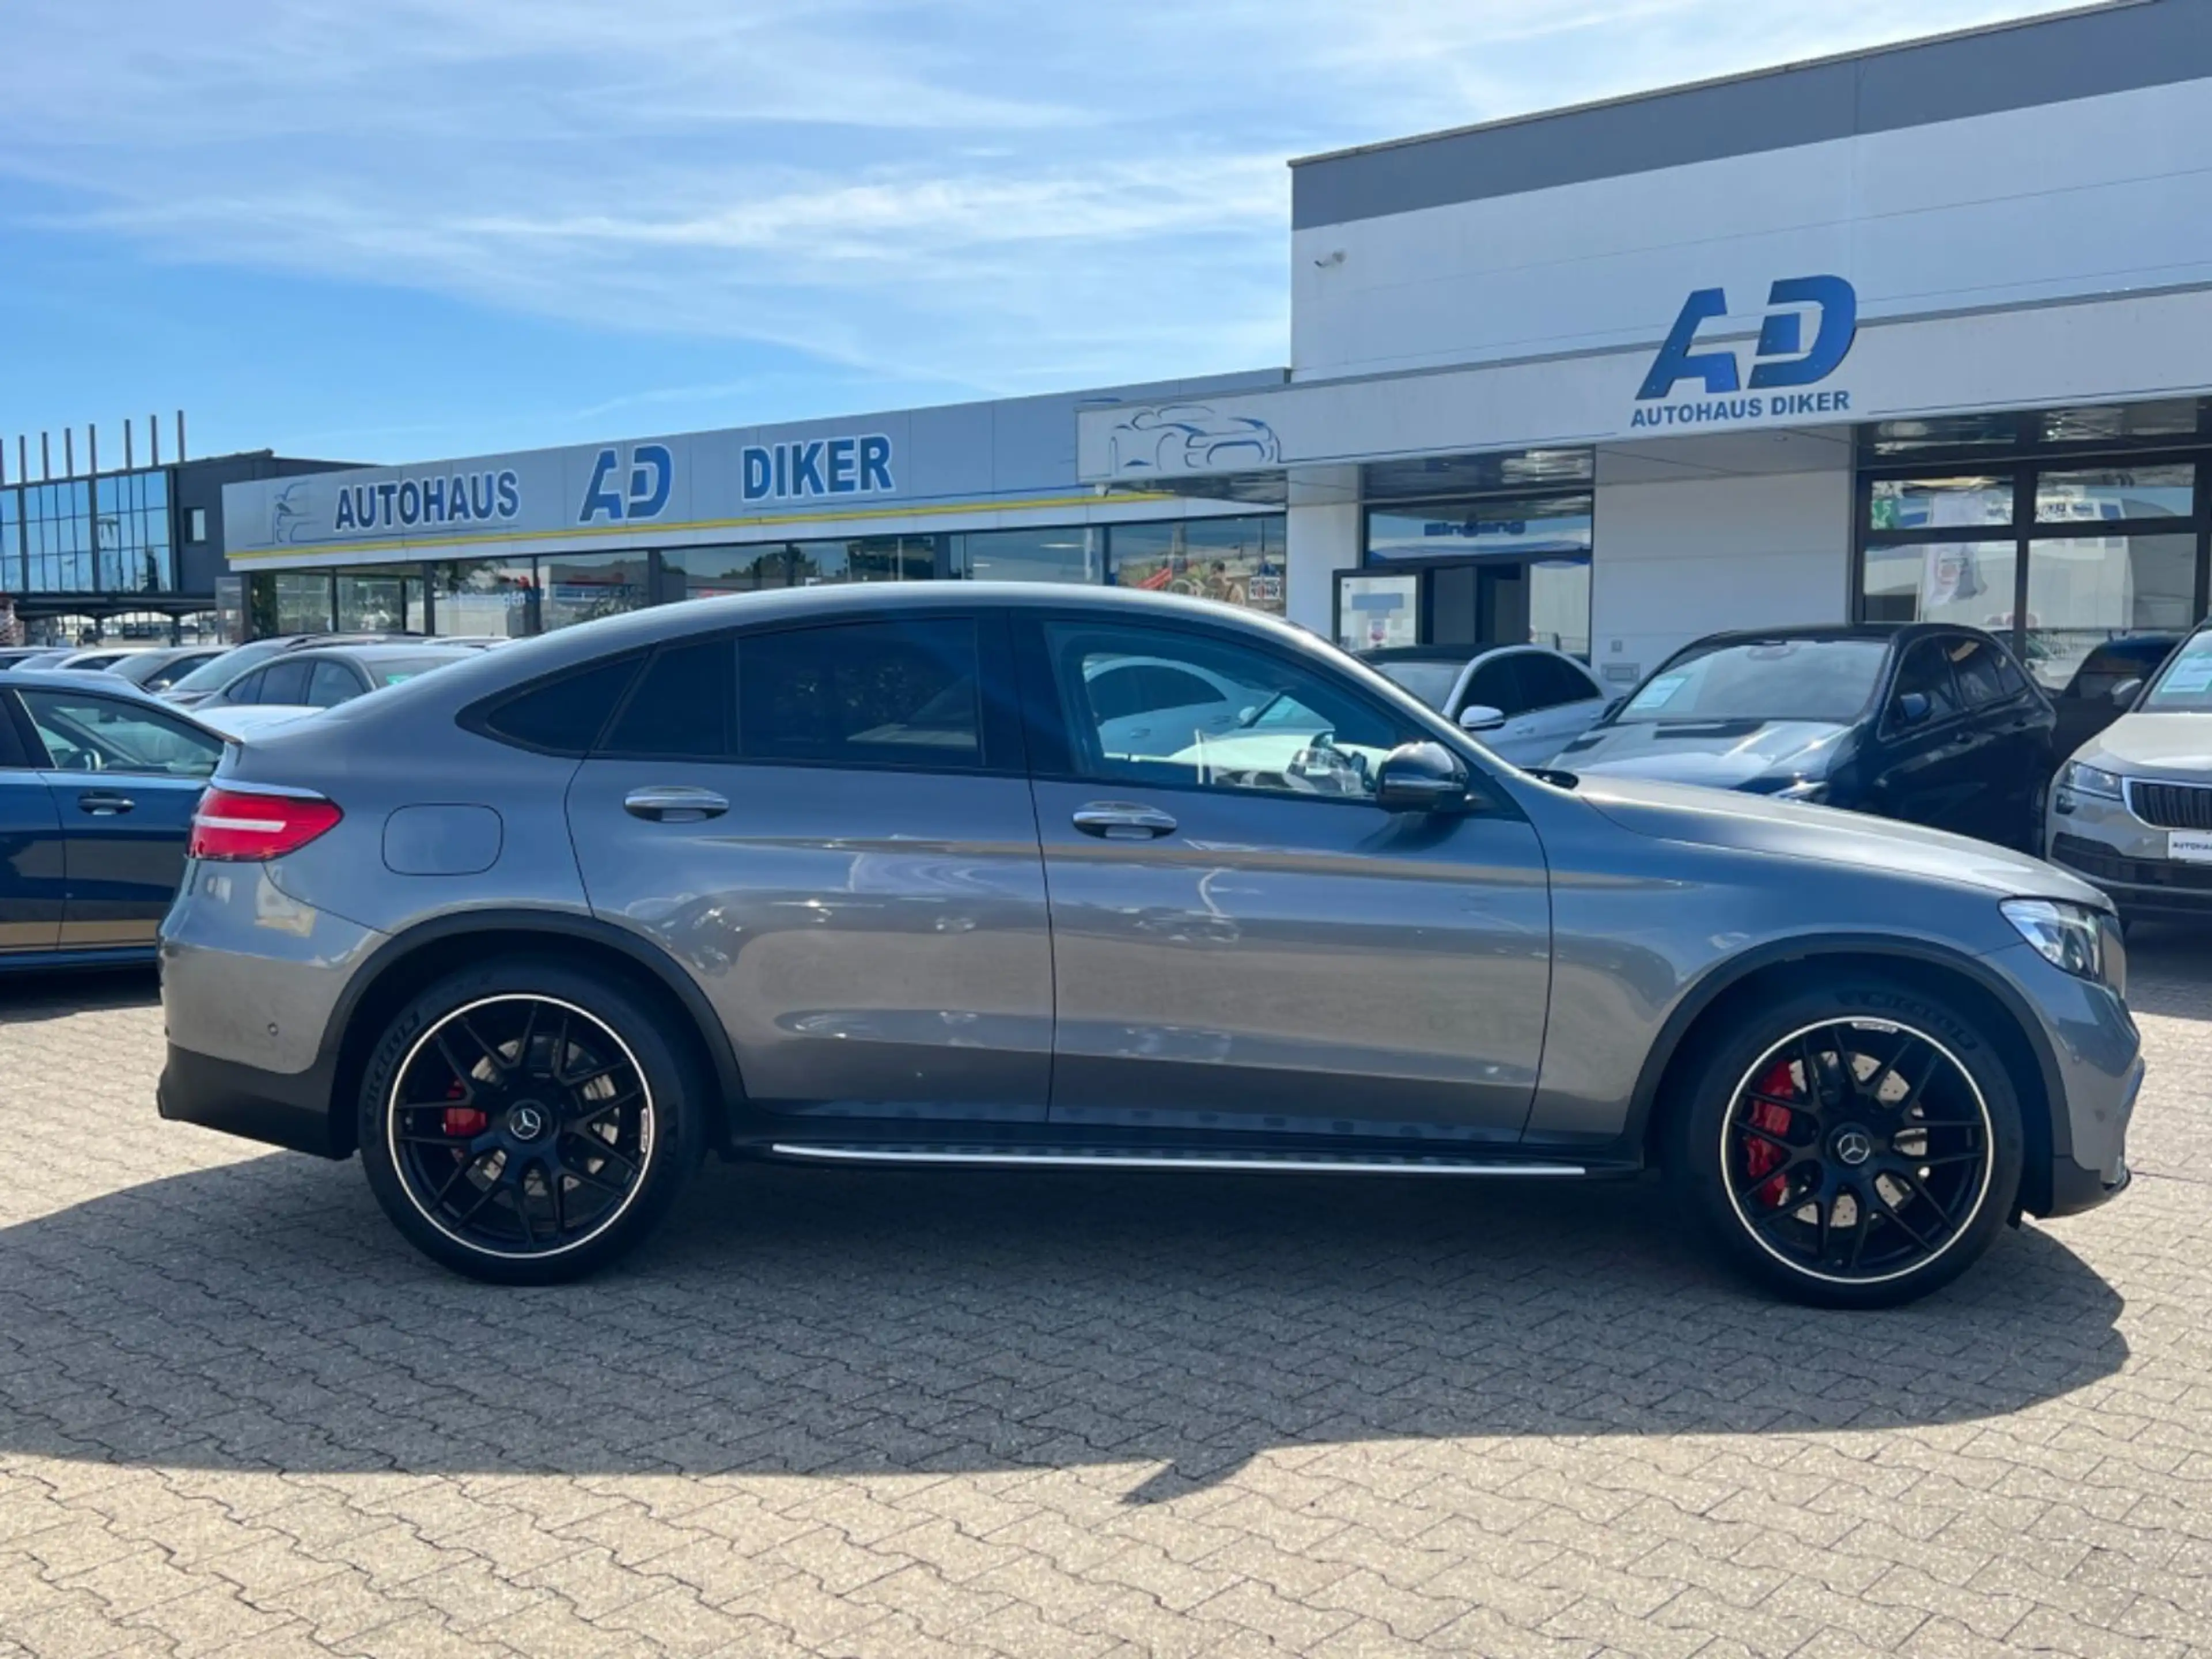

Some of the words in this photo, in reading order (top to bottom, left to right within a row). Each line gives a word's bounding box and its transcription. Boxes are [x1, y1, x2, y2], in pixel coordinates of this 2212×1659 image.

[1635, 275, 1857, 400] AD
[1631, 399, 1763, 427] AUTOHAUS
[1771, 391, 1850, 415] DIKER
[335, 470, 521, 531] AUTOHAUS
[578, 444, 674, 523] AD
[741, 433, 896, 500] DIKER
